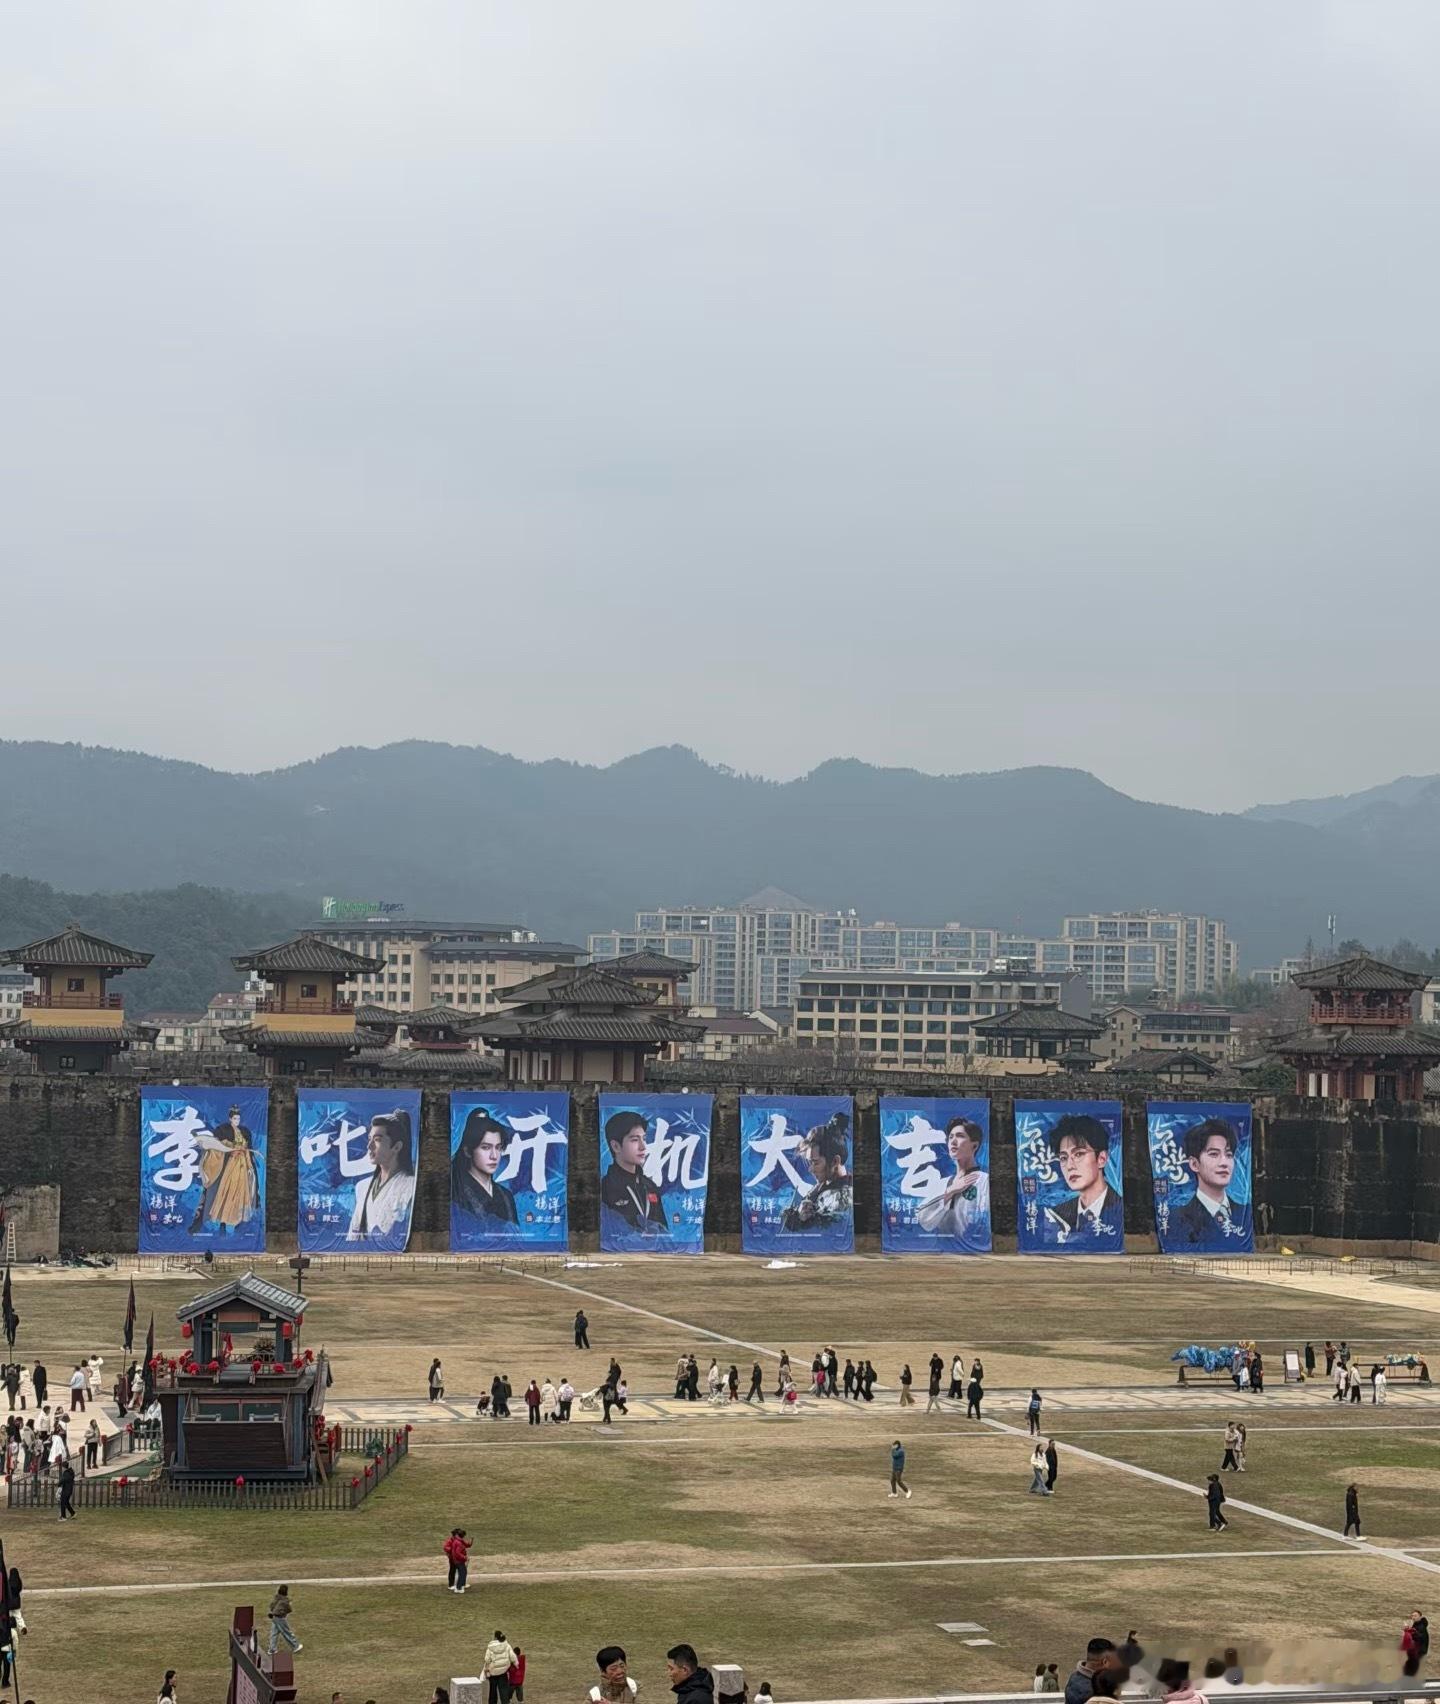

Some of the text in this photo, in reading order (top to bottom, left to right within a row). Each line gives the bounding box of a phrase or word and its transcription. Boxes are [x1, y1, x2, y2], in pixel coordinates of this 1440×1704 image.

[148, 1105, 213, 1191] 李
[301, 1119, 376, 1178] 叱
[495, 1114, 568, 1193] 开
[643, 1117, 708, 1190] 机
[746, 1113, 816, 1197] 大
[884, 1115, 953, 1198] 吉
[1092, 1216, 1116, 1236] 李叱
[1222, 1217, 1246, 1237] 李叱
